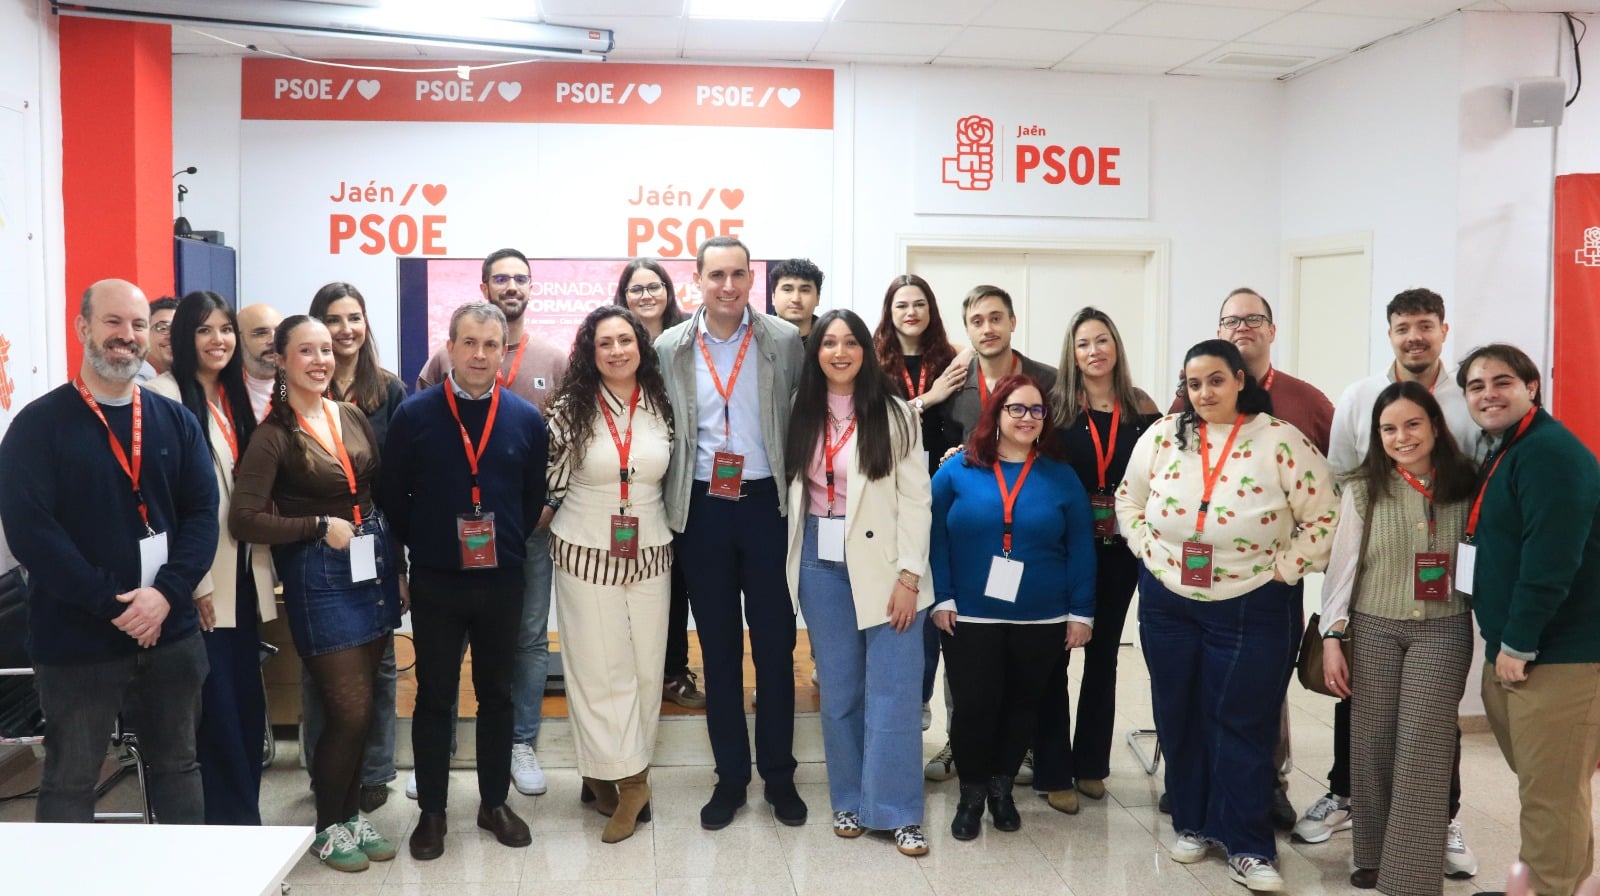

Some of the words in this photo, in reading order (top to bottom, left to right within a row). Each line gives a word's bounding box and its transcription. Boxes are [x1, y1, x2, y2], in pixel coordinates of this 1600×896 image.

[274, 78, 333, 100] PSOE
[415, 80, 474, 102] PSOE
[556, 82, 615, 105] PSOE
[696, 85, 754, 107] PSOE
[1017, 125, 1047, 137] Jaén
[1016, 144, 1121, 186] PSOE
[330, 180, 394, 203] Jaén
[628, 184, 692, 206] Jaén
[330, 214, 447, 255] PSOE
[530, 282, 604, 296] ORNADA
